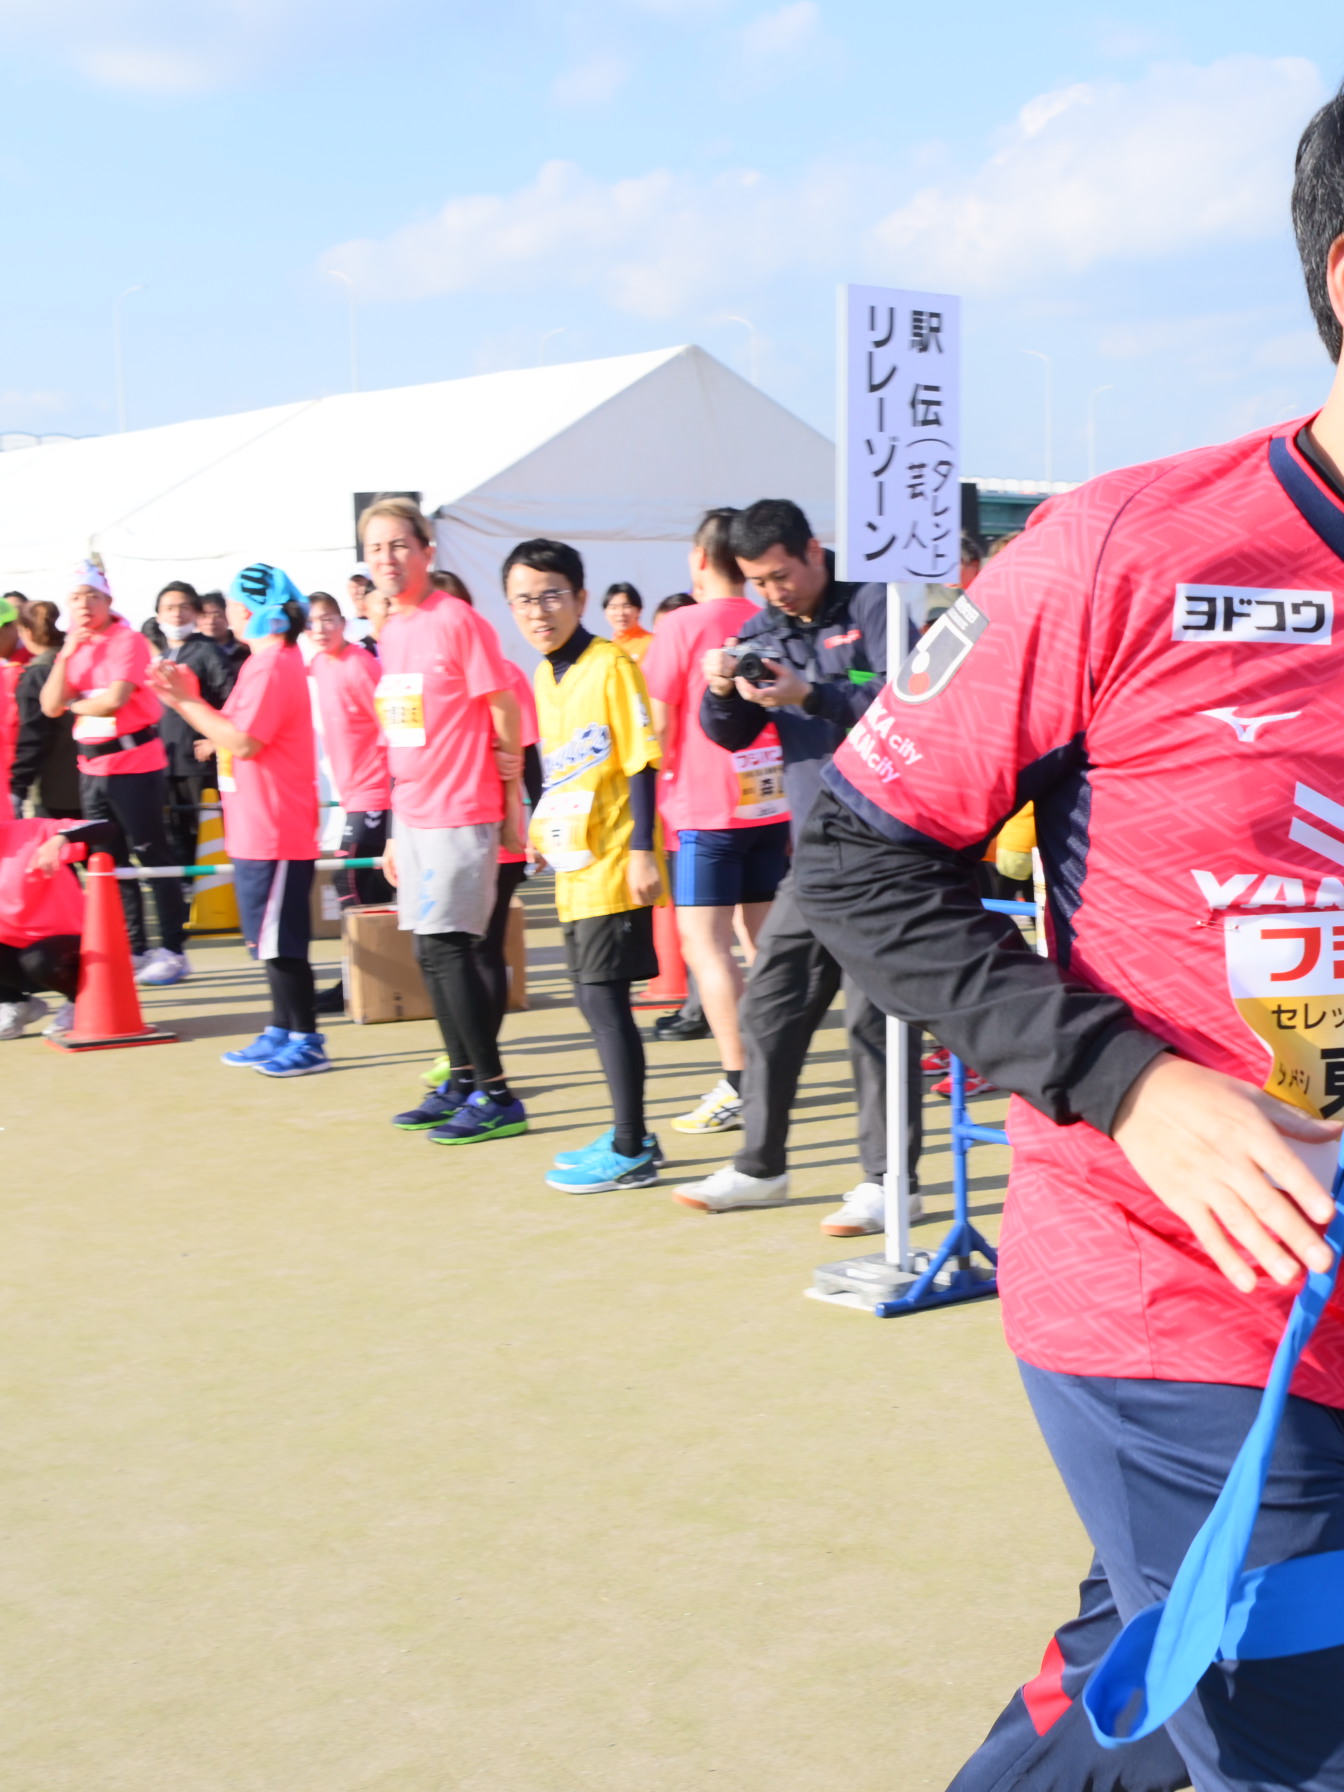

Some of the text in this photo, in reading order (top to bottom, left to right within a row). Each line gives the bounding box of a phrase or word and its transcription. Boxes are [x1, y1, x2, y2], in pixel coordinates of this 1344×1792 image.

[865, 305, 899, 562] リレーゾーン
[1182, 596, 1325, 633] ヨドコウ
[888, 734, 923, 766] city
[867, 753, 900, 783] city
